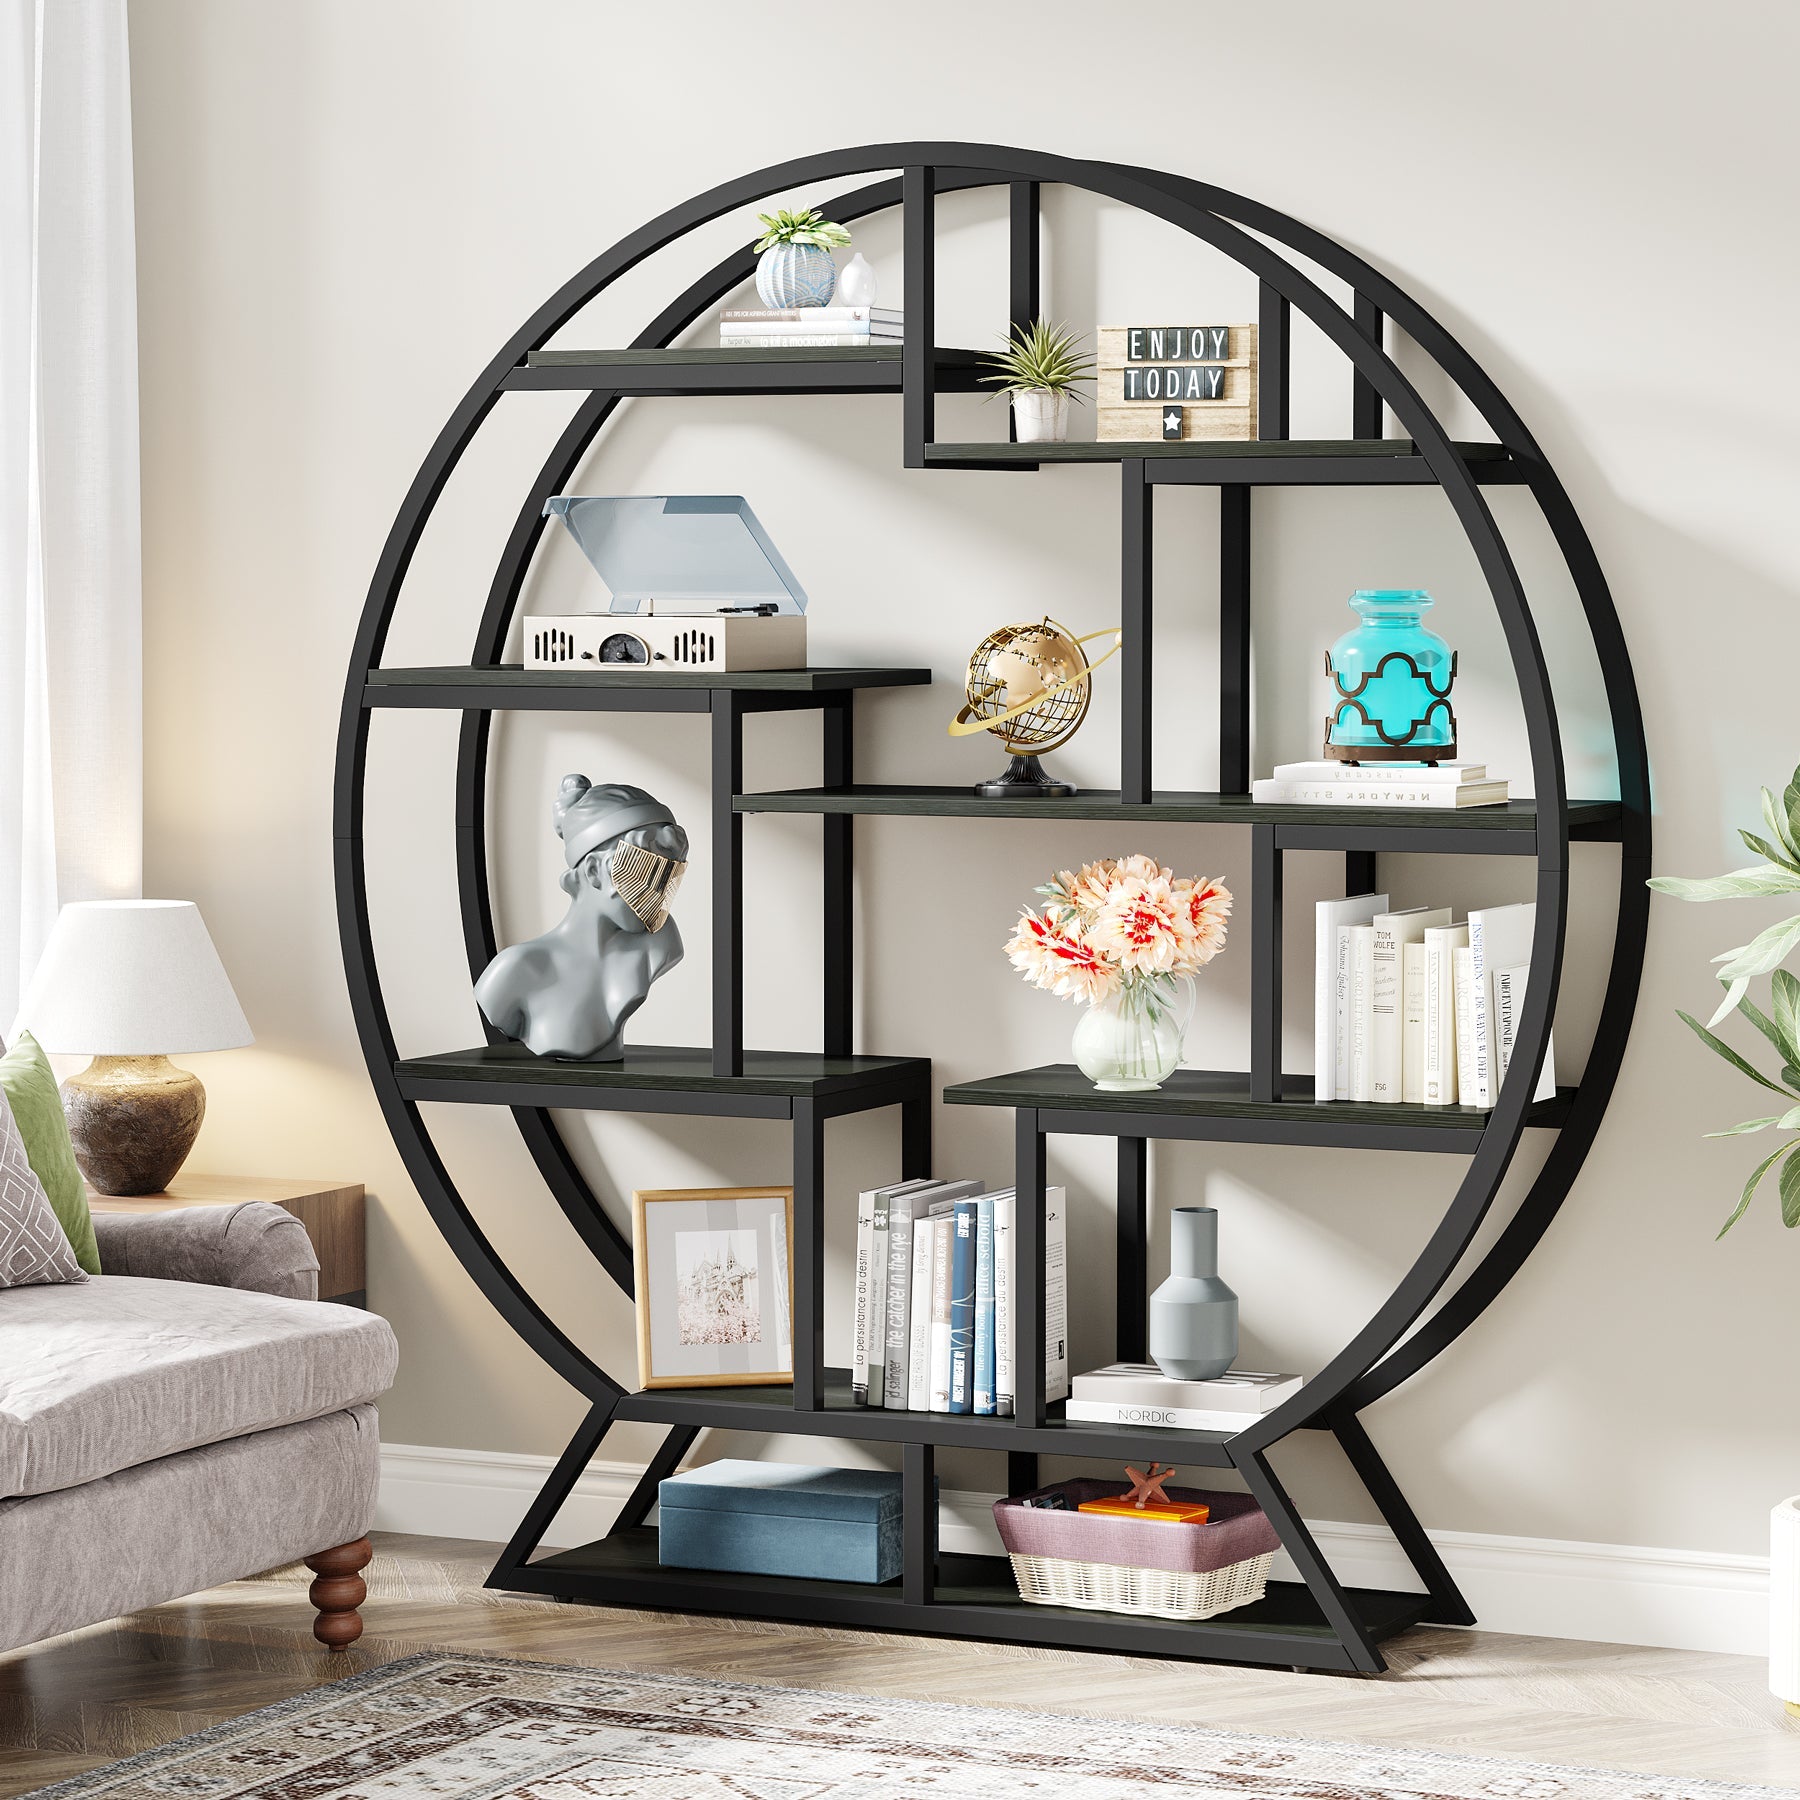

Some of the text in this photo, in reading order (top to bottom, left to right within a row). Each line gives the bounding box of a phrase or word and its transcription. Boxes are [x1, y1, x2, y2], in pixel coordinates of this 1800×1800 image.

[1131, 329, 1225, 359] ENJOY
[1127, 369, 1222, 399] TODAY
[1373, 941, 1395, 950] WOLFE
[1377, 931, 1392, 940] TOM
[1472, 923, 1484, 980] INSPIRATION
[1476, 1013, 1486, 1043] WAYNE
[1477, 1056, 1487, 1079] DYER
[1375, 1083, 1386, 1091] FSG
[976, 1214, 990, 1294] alice sebold
[887, 1232, 911, 1348] the catcher in the rye
[855, 1249, 868, 1366] La persistance du destin
[998, 1258, 1011, 1376] La persistance du destin
[975, 1331, 987, 1356] lovely
[886, 1360, 902, 1387] salinger
[1118, 1409, 1177, 1424] NORDIC
